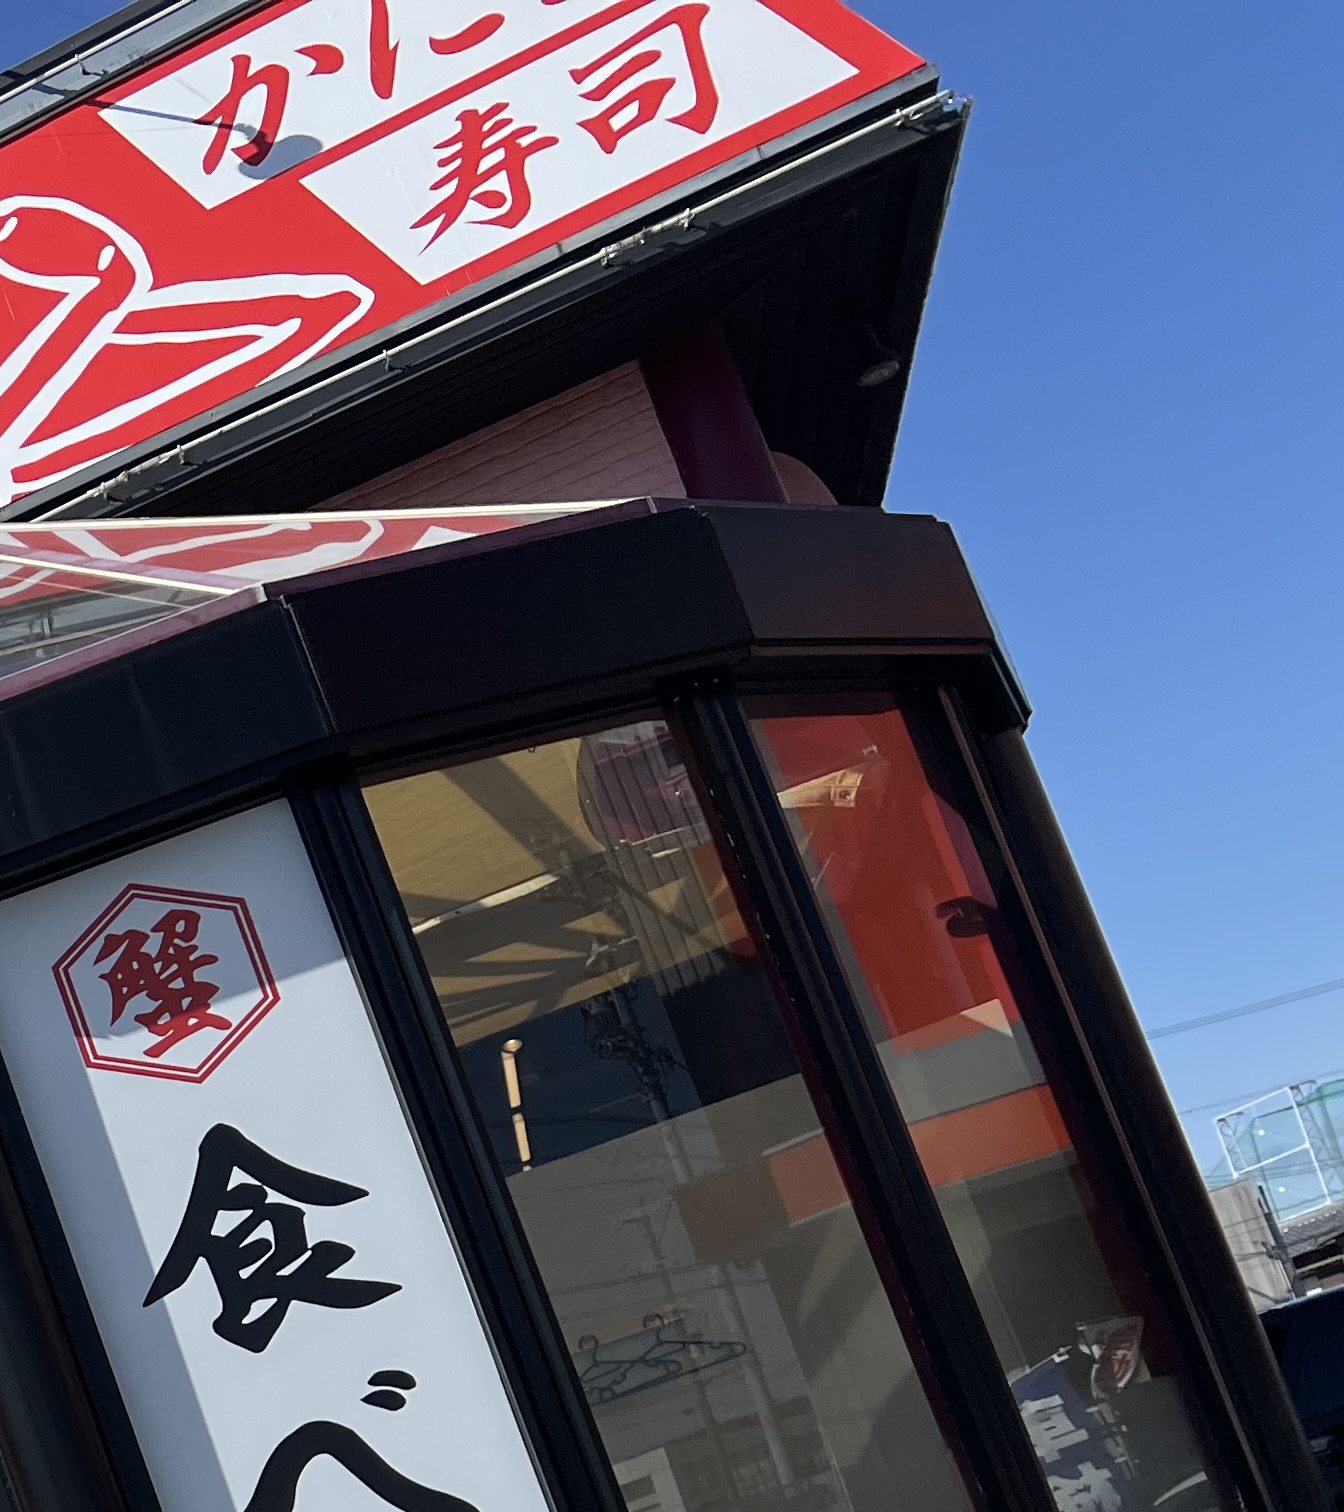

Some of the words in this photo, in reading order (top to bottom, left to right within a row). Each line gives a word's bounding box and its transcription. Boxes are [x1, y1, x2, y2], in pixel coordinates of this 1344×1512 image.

[192, 0, 568, 176] かに
[410, 3, 720, 255] 寿司
[94, 908, 232, 1059] 蟹
